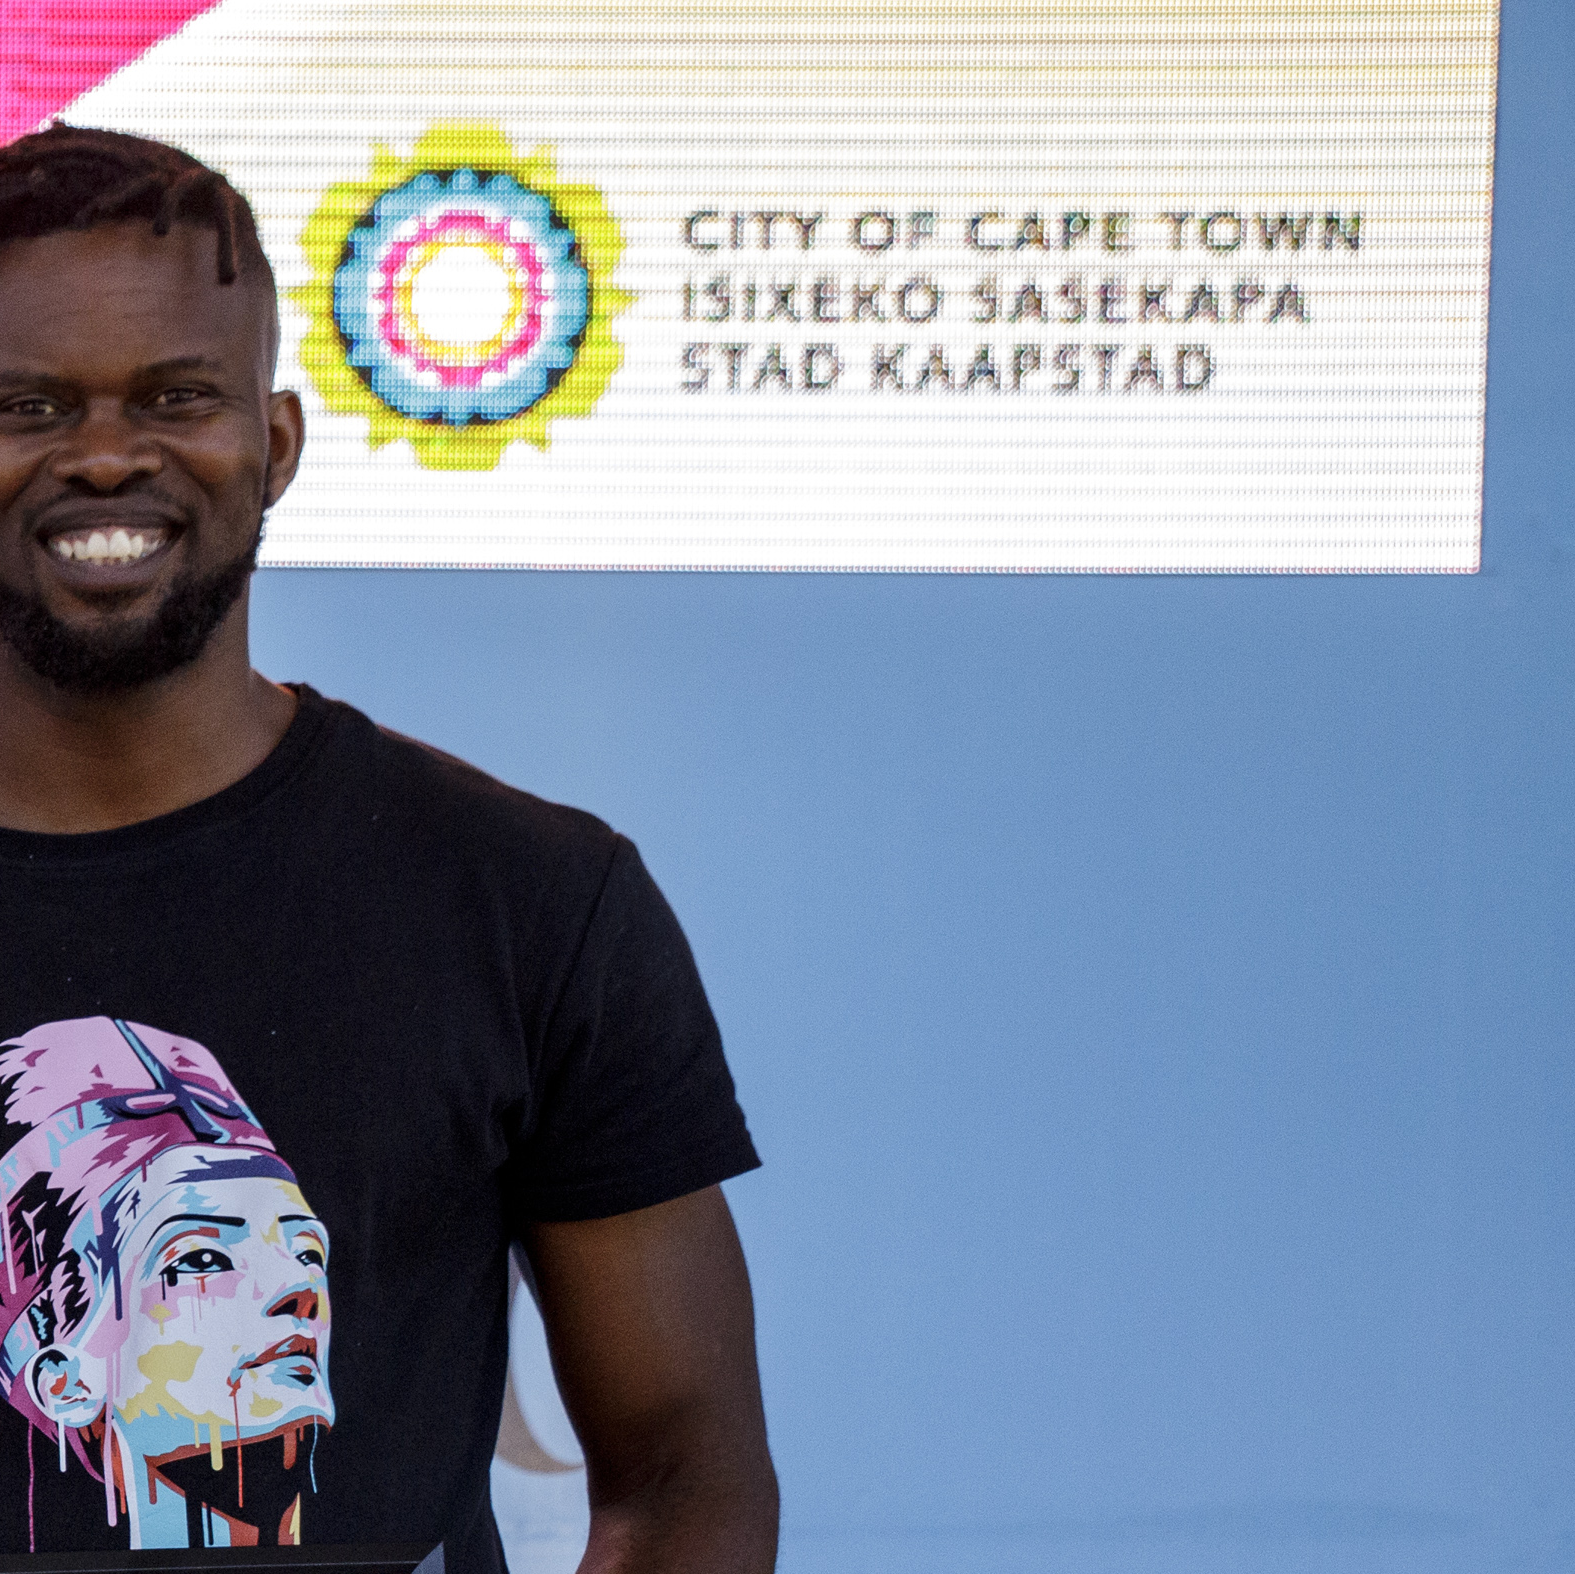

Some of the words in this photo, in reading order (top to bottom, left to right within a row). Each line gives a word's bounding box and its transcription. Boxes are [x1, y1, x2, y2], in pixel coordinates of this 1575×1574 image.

[681, 211, 823, 254] CITY
[851, 211, 936, 254] OF
[969, 211, 1130, 254] CAPE
[1168, 211, 1364, 254] TOWN
[683, 277, 944, 325] ISIXEKO
[972, 279, 1310, 325] SASEKAPA
[679, 343, 843, 393] STAD
[871, 344, 1217, 395] KAAPSTAD
